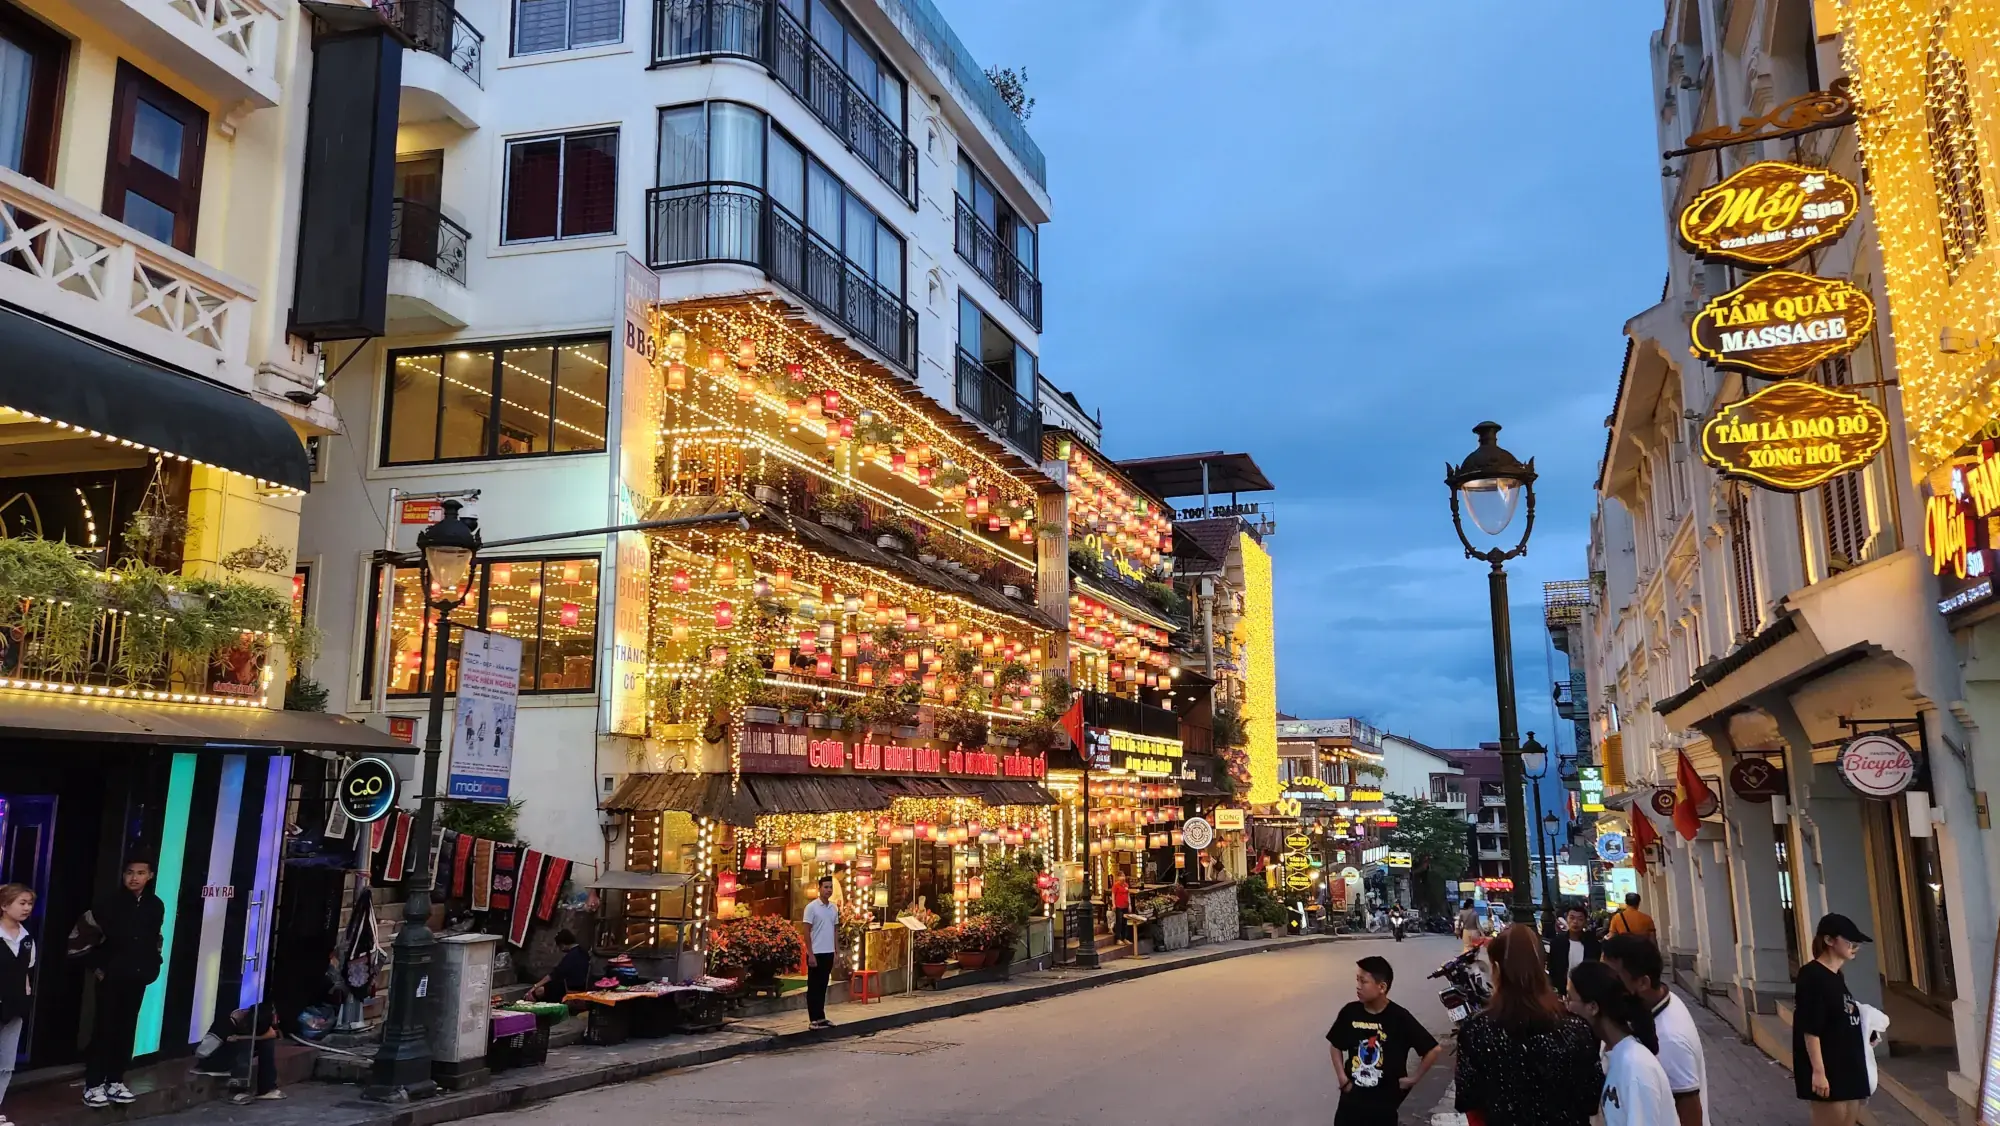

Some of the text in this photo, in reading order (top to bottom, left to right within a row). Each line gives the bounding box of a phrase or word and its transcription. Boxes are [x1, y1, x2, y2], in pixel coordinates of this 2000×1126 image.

[626, 319, 657, 368] BBQ
[1720, 318, 1848, 352] MASSAGE
[1761, 415, 1789, 440] LÁ
[1748, 442, 1843, 468] XÔNG HƠI
[809, 737, 844, 768] CƠM
[884, 740, 914, 771] BÌNH
[916, 742, 940, 772] DÂN
[1844, 751, 1913, 778] Bicycle
[456, 780, 502, 794] mobifone
[222, 886, 233, 897] RA
